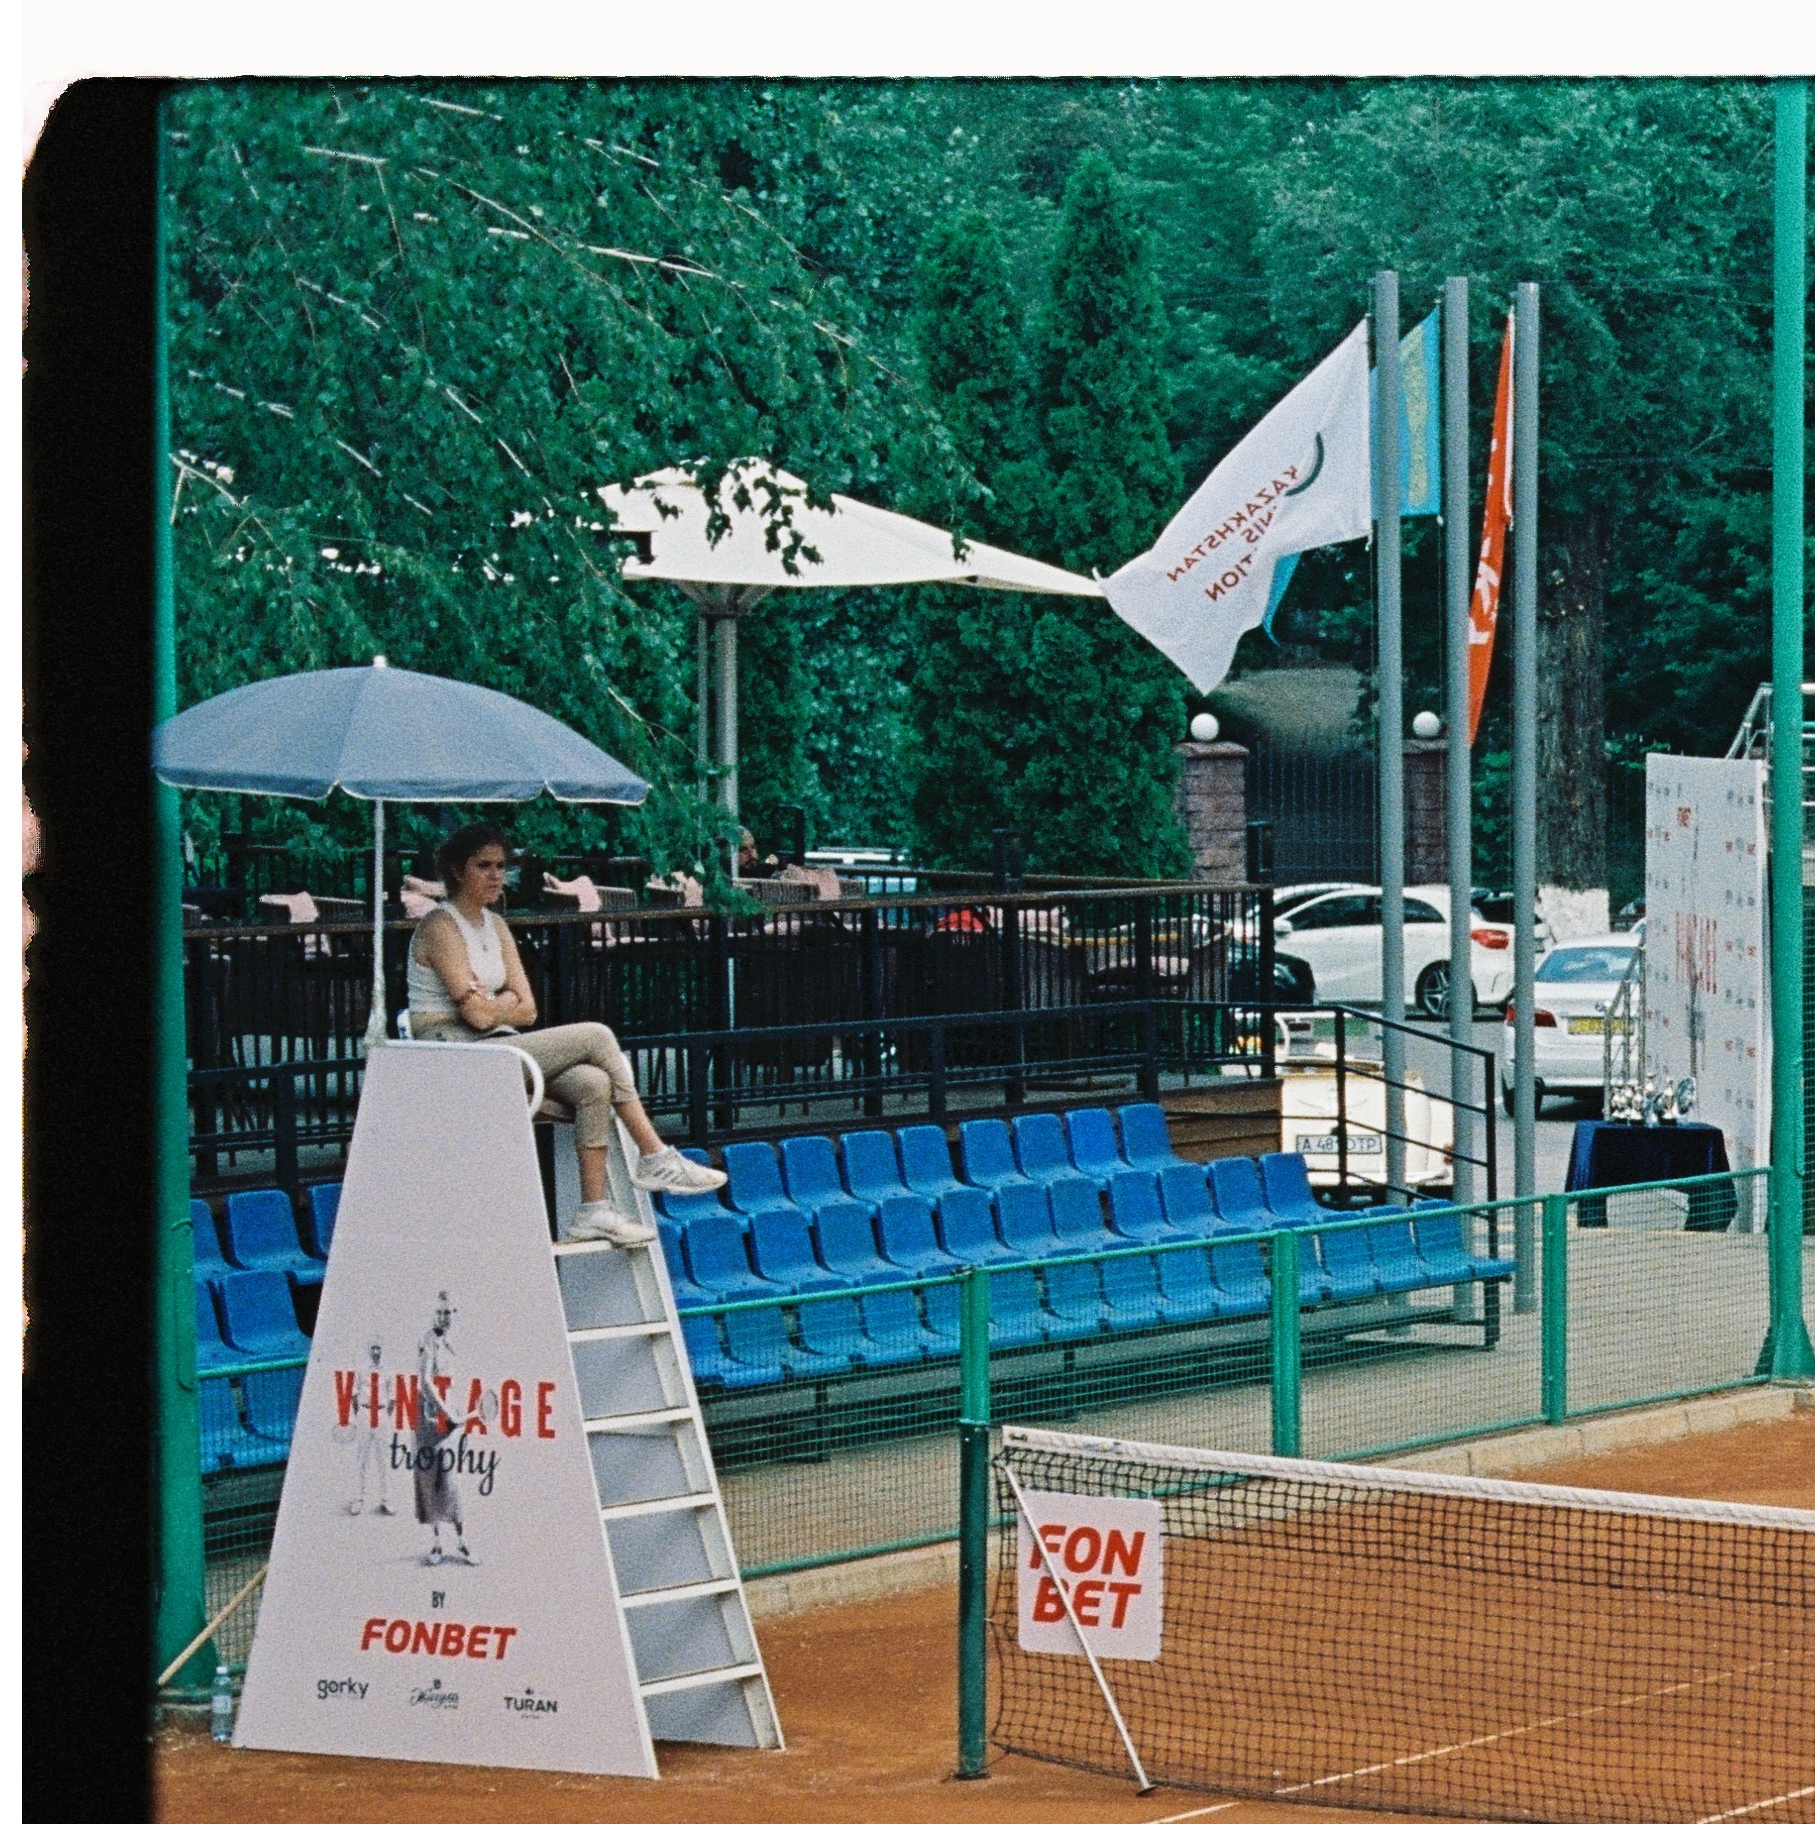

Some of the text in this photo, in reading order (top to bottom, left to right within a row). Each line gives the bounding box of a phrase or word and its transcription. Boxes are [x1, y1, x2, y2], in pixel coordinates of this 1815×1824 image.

[334, 1371, 556, 1439] VINTAGE
[390, 1432, 500, 1496] trophy
[1028, 1524, 1146, 1577] FON
[432, 1591, 446, 1608] BY
[1032, 1576, 1142, 1629] BET
[360, 1618, 518, 1660] FONBET
[317, 1676, 369, 1700] gorky
[503, 1696, 557, 1713] TURAN
